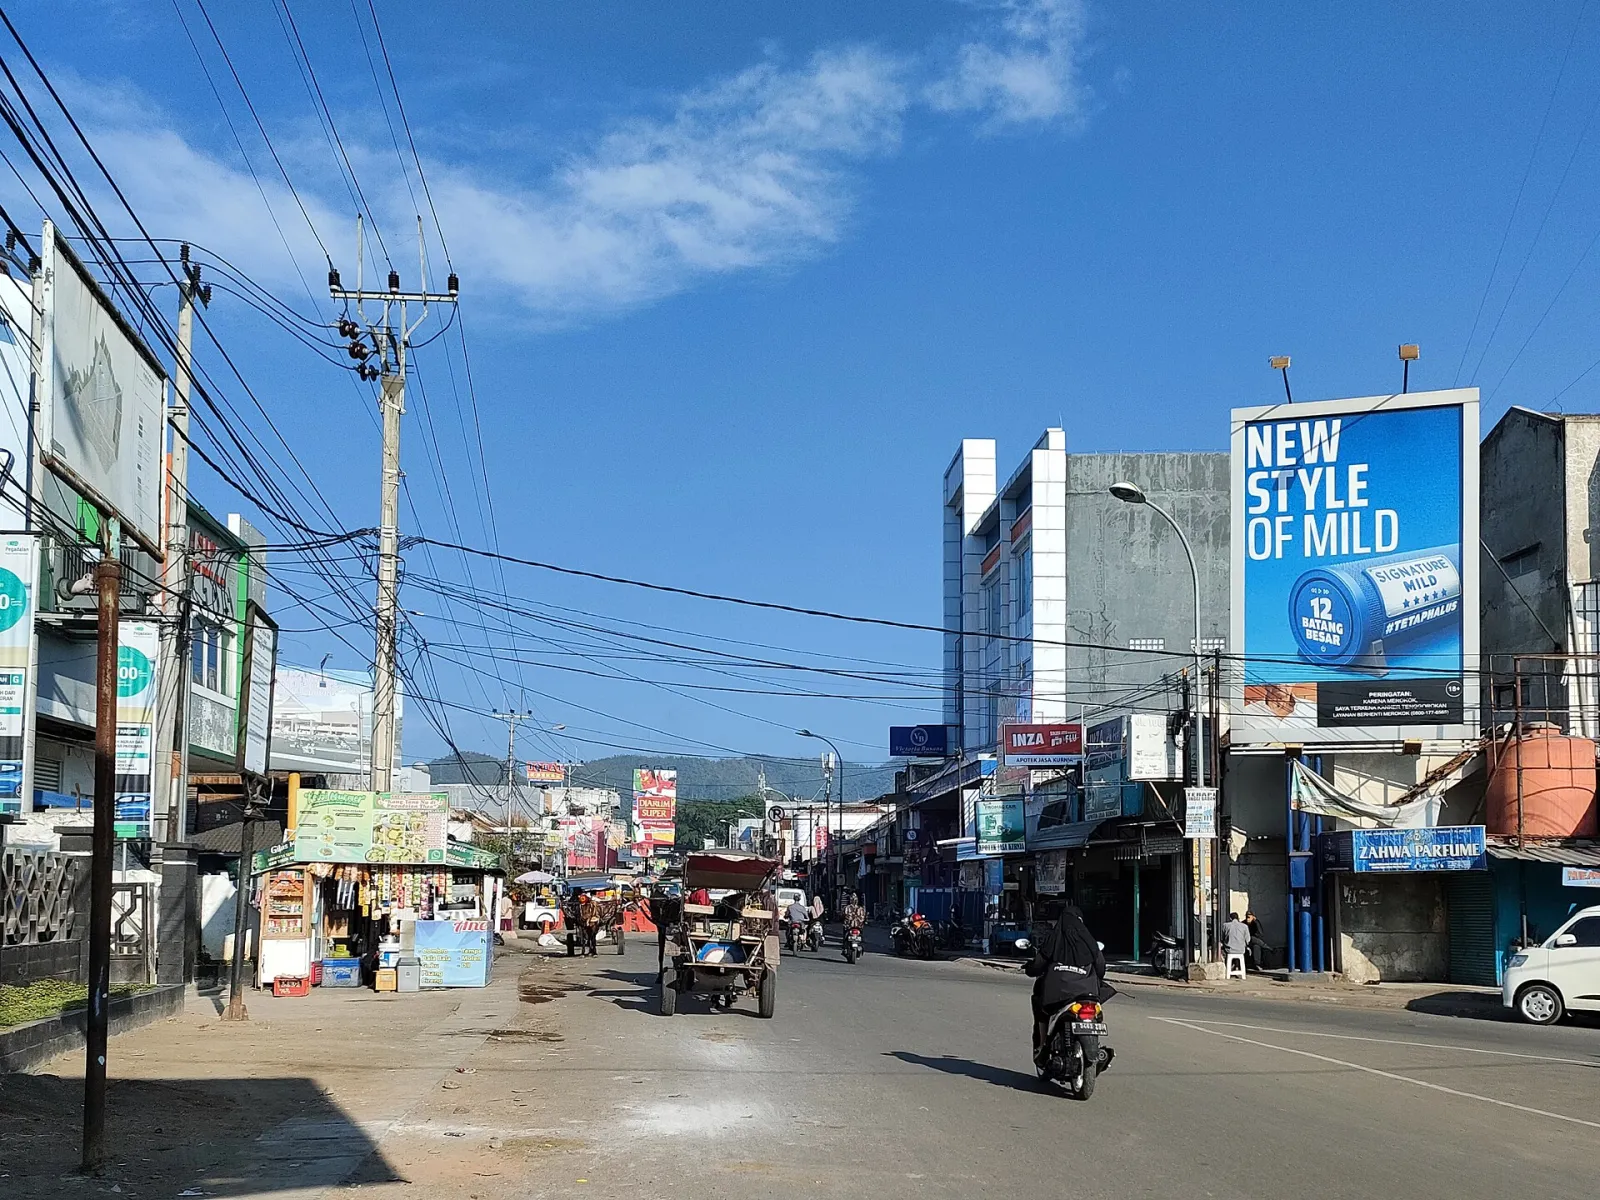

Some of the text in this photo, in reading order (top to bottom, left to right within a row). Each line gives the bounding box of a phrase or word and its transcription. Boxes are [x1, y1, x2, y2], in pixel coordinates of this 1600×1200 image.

[1247, 419, 1342, 468] NEW
[1247, 463, 1369, 514] STYLE
[1248, 509, 1399, 561] OF MILD
[1374, 558, 1449, 583] SIGNATURE
[1402, 575, 1438, 593] MILD
[1310, 597, 1333, 620] 12
[1385, 600, 1459, 635] #TETAPHALUS
[1302, 617, 1344, 635] BATANG
[1305, 629, 1342, 646] BESAR
[1011, 732, 1045, 748] INZA
[639, 799, 671, 808] DJARUM
[641, 809, 667, 817] SUPER
[1359, 843, 1481, 859] ZAHWA PARFUME
